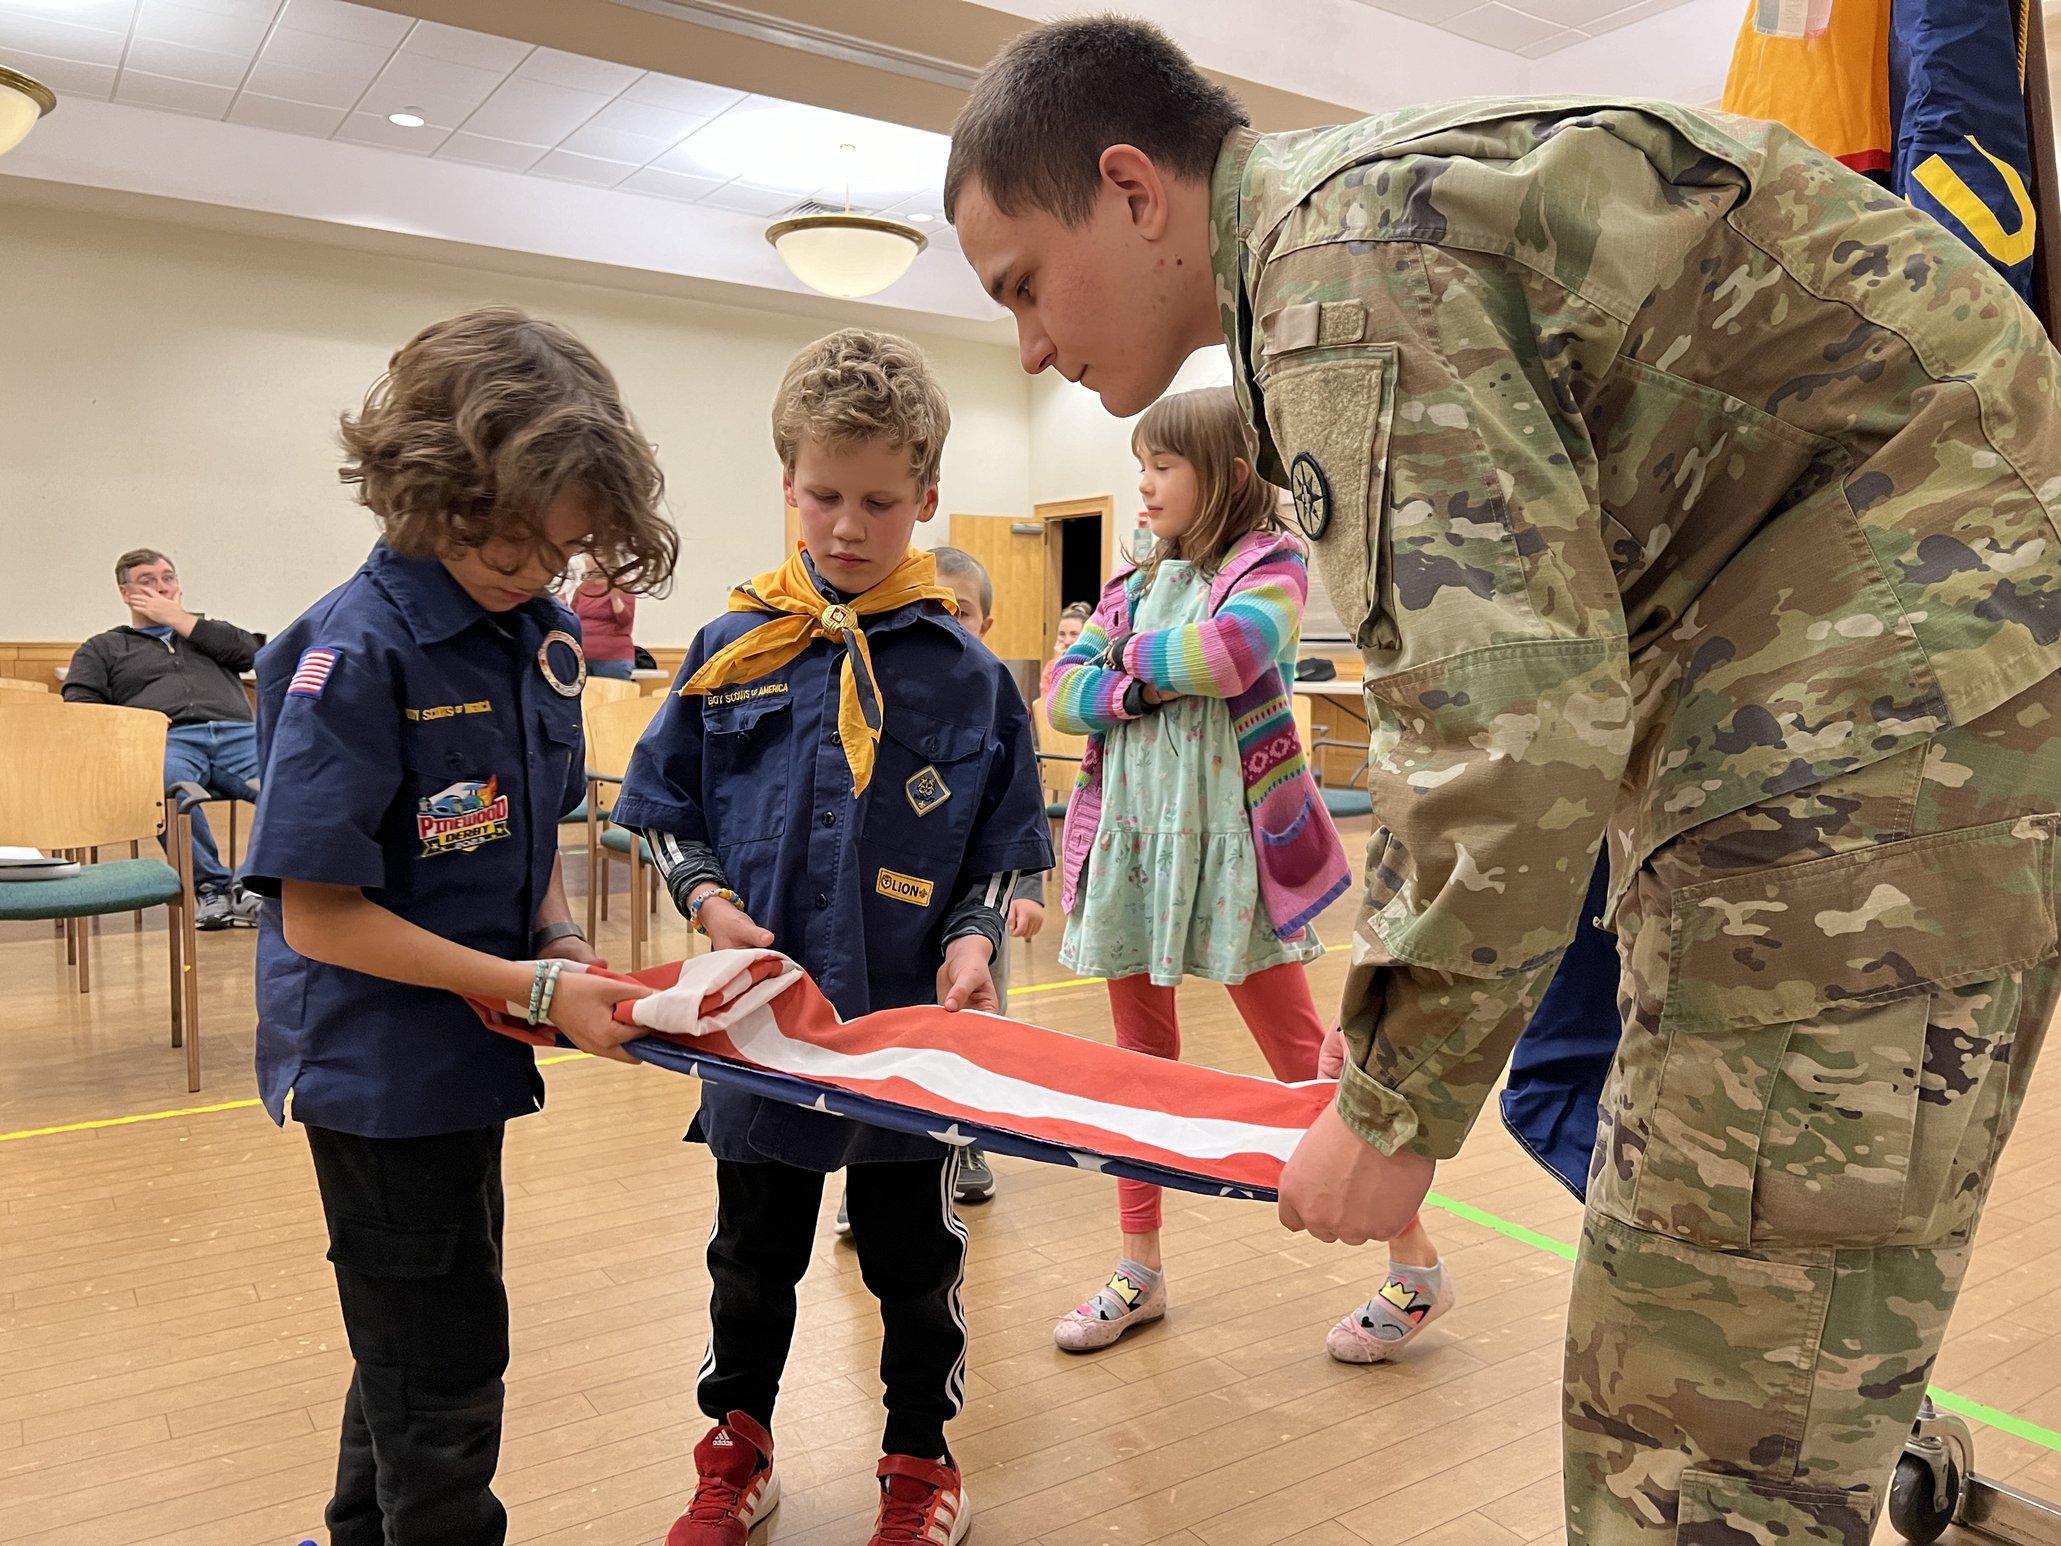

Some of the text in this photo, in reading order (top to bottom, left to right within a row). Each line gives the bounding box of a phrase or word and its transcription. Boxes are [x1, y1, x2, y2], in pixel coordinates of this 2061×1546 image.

[707, 683, 788, 706] BOY SCOUTS OF AMERICA
[420, 798, 507, 838] PINEWOOD
[445, 825, 489, 843] DERBY
[891, 879, 920, 897] LION
